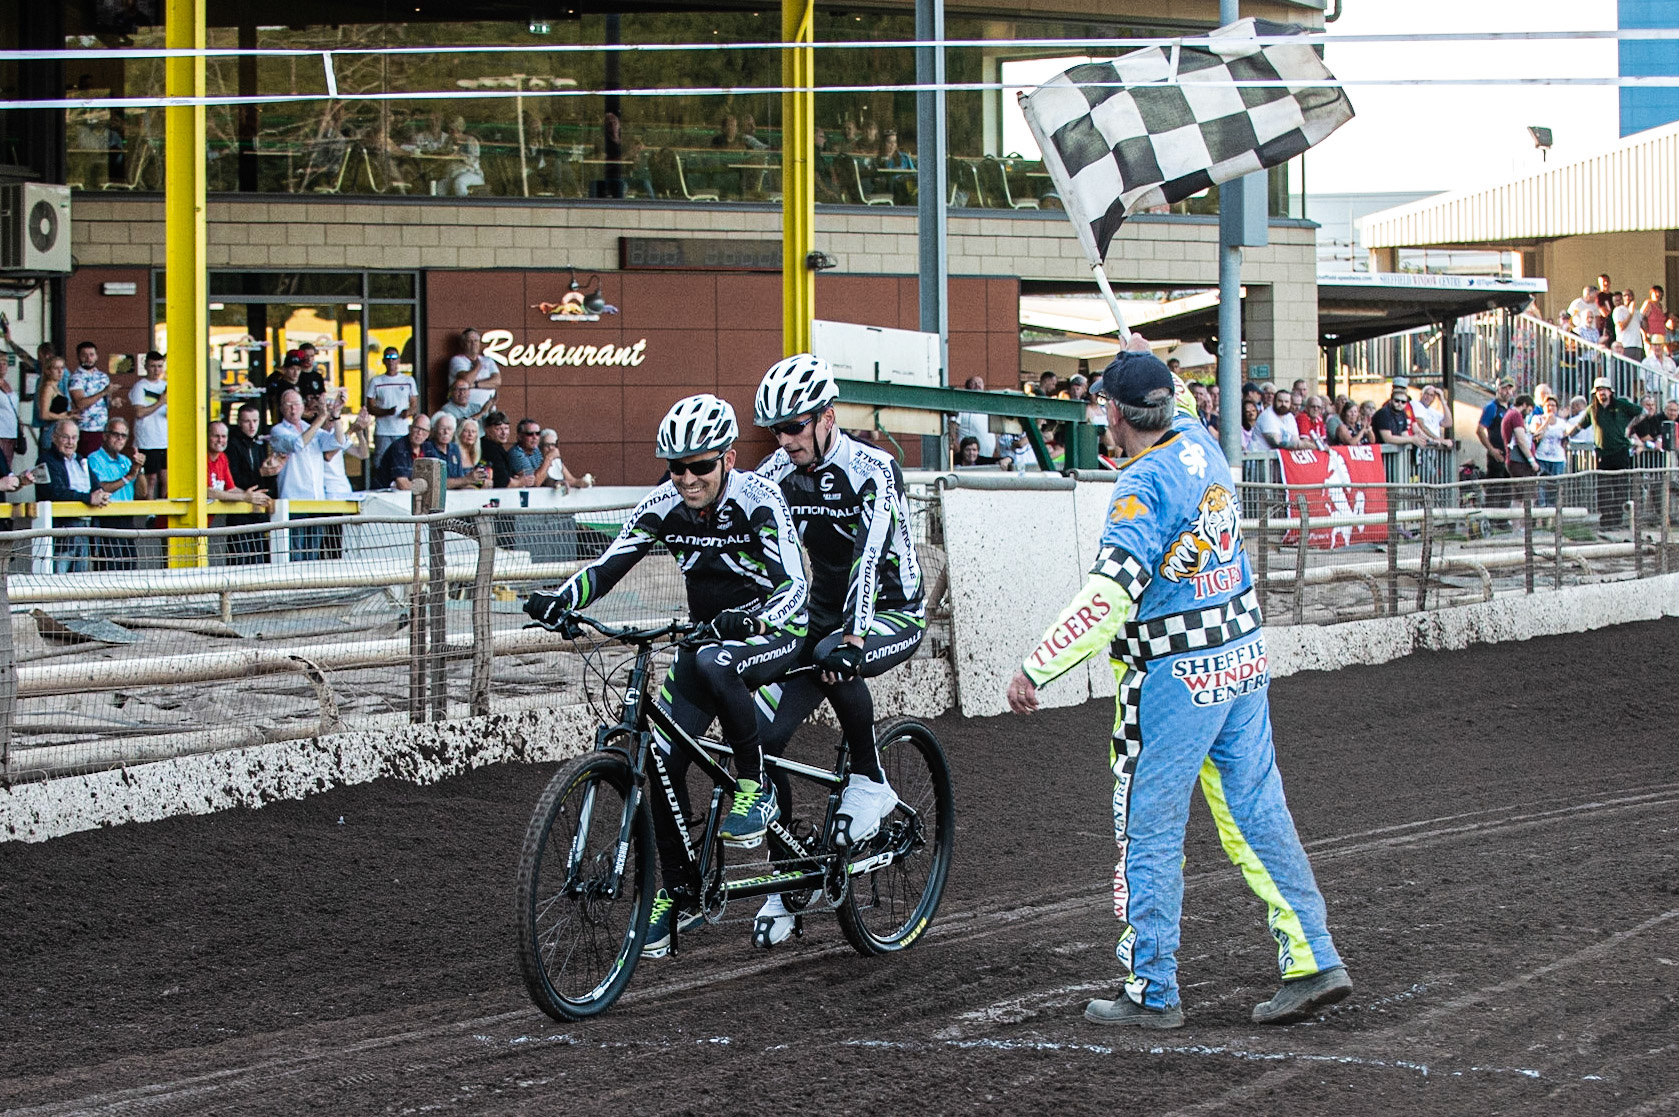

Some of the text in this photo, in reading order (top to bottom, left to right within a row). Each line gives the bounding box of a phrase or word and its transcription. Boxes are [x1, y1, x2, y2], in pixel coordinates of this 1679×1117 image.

[481, 329, 647, 367] Restaurant
[1289, 445, 1375, 465] KENT KINGS
[791, 505, 861, 519] NNONDALE
[865, 631, 922, 664] CANNONDALE
[1031, 593, 1111, 667] TIGERS
[736, 639, 798, 674] CANNONDALE
[1174, 640, 1266, 677] SHEFFIE
[1183, 656, 1268, 691] WINDO
[863, 851, 894, 875] 29
